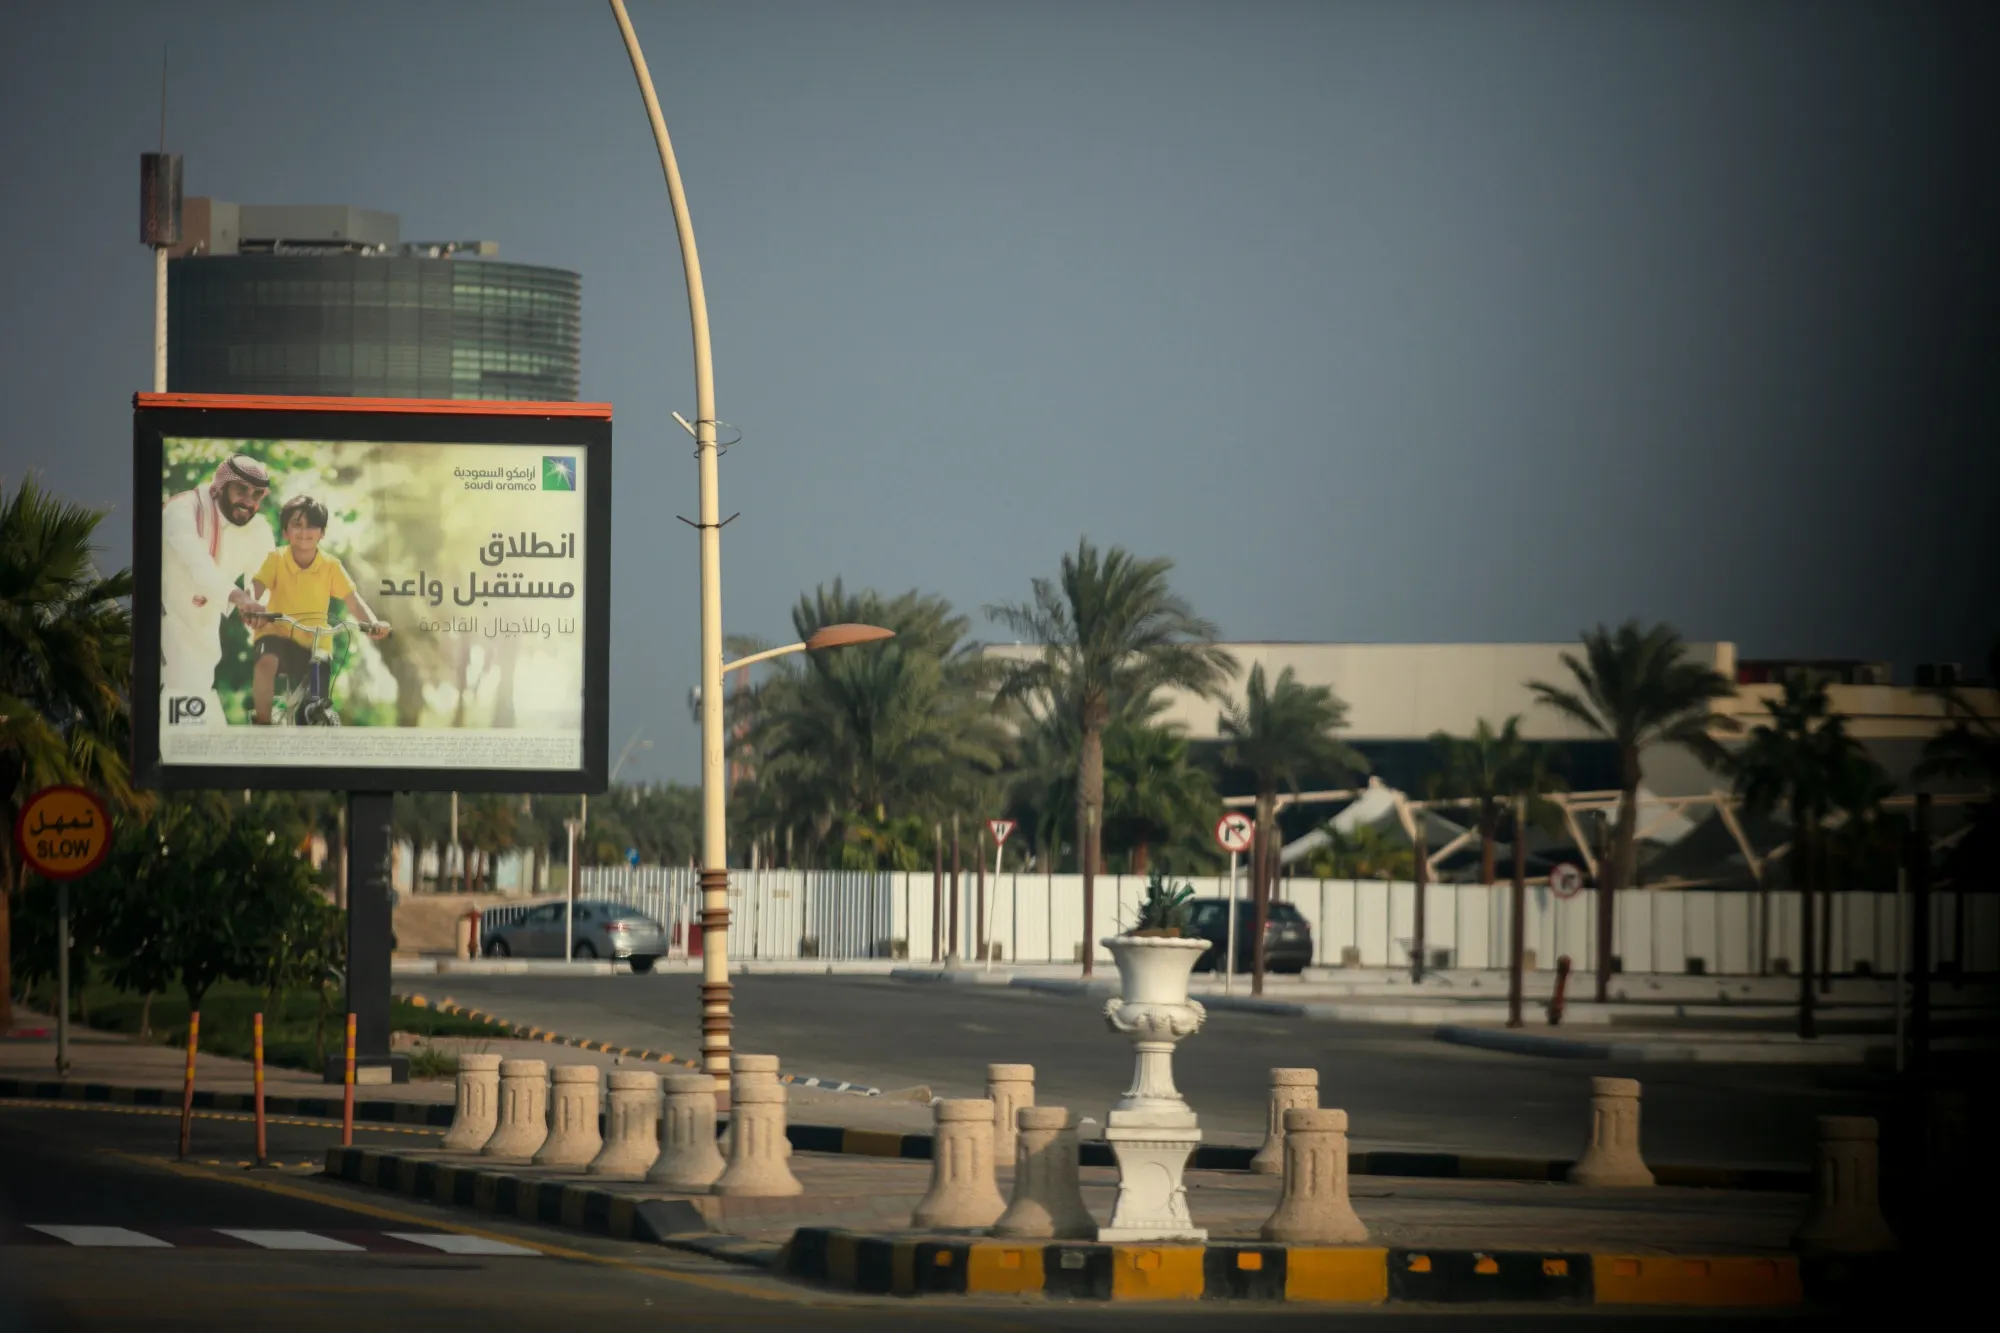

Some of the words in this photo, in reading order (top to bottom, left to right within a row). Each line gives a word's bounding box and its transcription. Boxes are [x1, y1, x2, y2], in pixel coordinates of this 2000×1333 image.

[454, 466, 504, 480] السعودية
[506, 466, 536, 481] أرامكو
[464, 480, 494, 490] saudi
[496, 481, 536, 491] aramco
[480, 532, 575, 566] انطلاق
[380, 571, 444, 606] واعد
[454, 572, 575, 607] مستقبل
[419, 616, 478, 633] القادمة
[484, 616, 551, 639] وللأجيال
[557, 617, 575, 634] لنا
[169, 696, 206, 724] IPO
[30, 808, 94, 836] تمهل
[36, 838, 91, 859] SLOW
